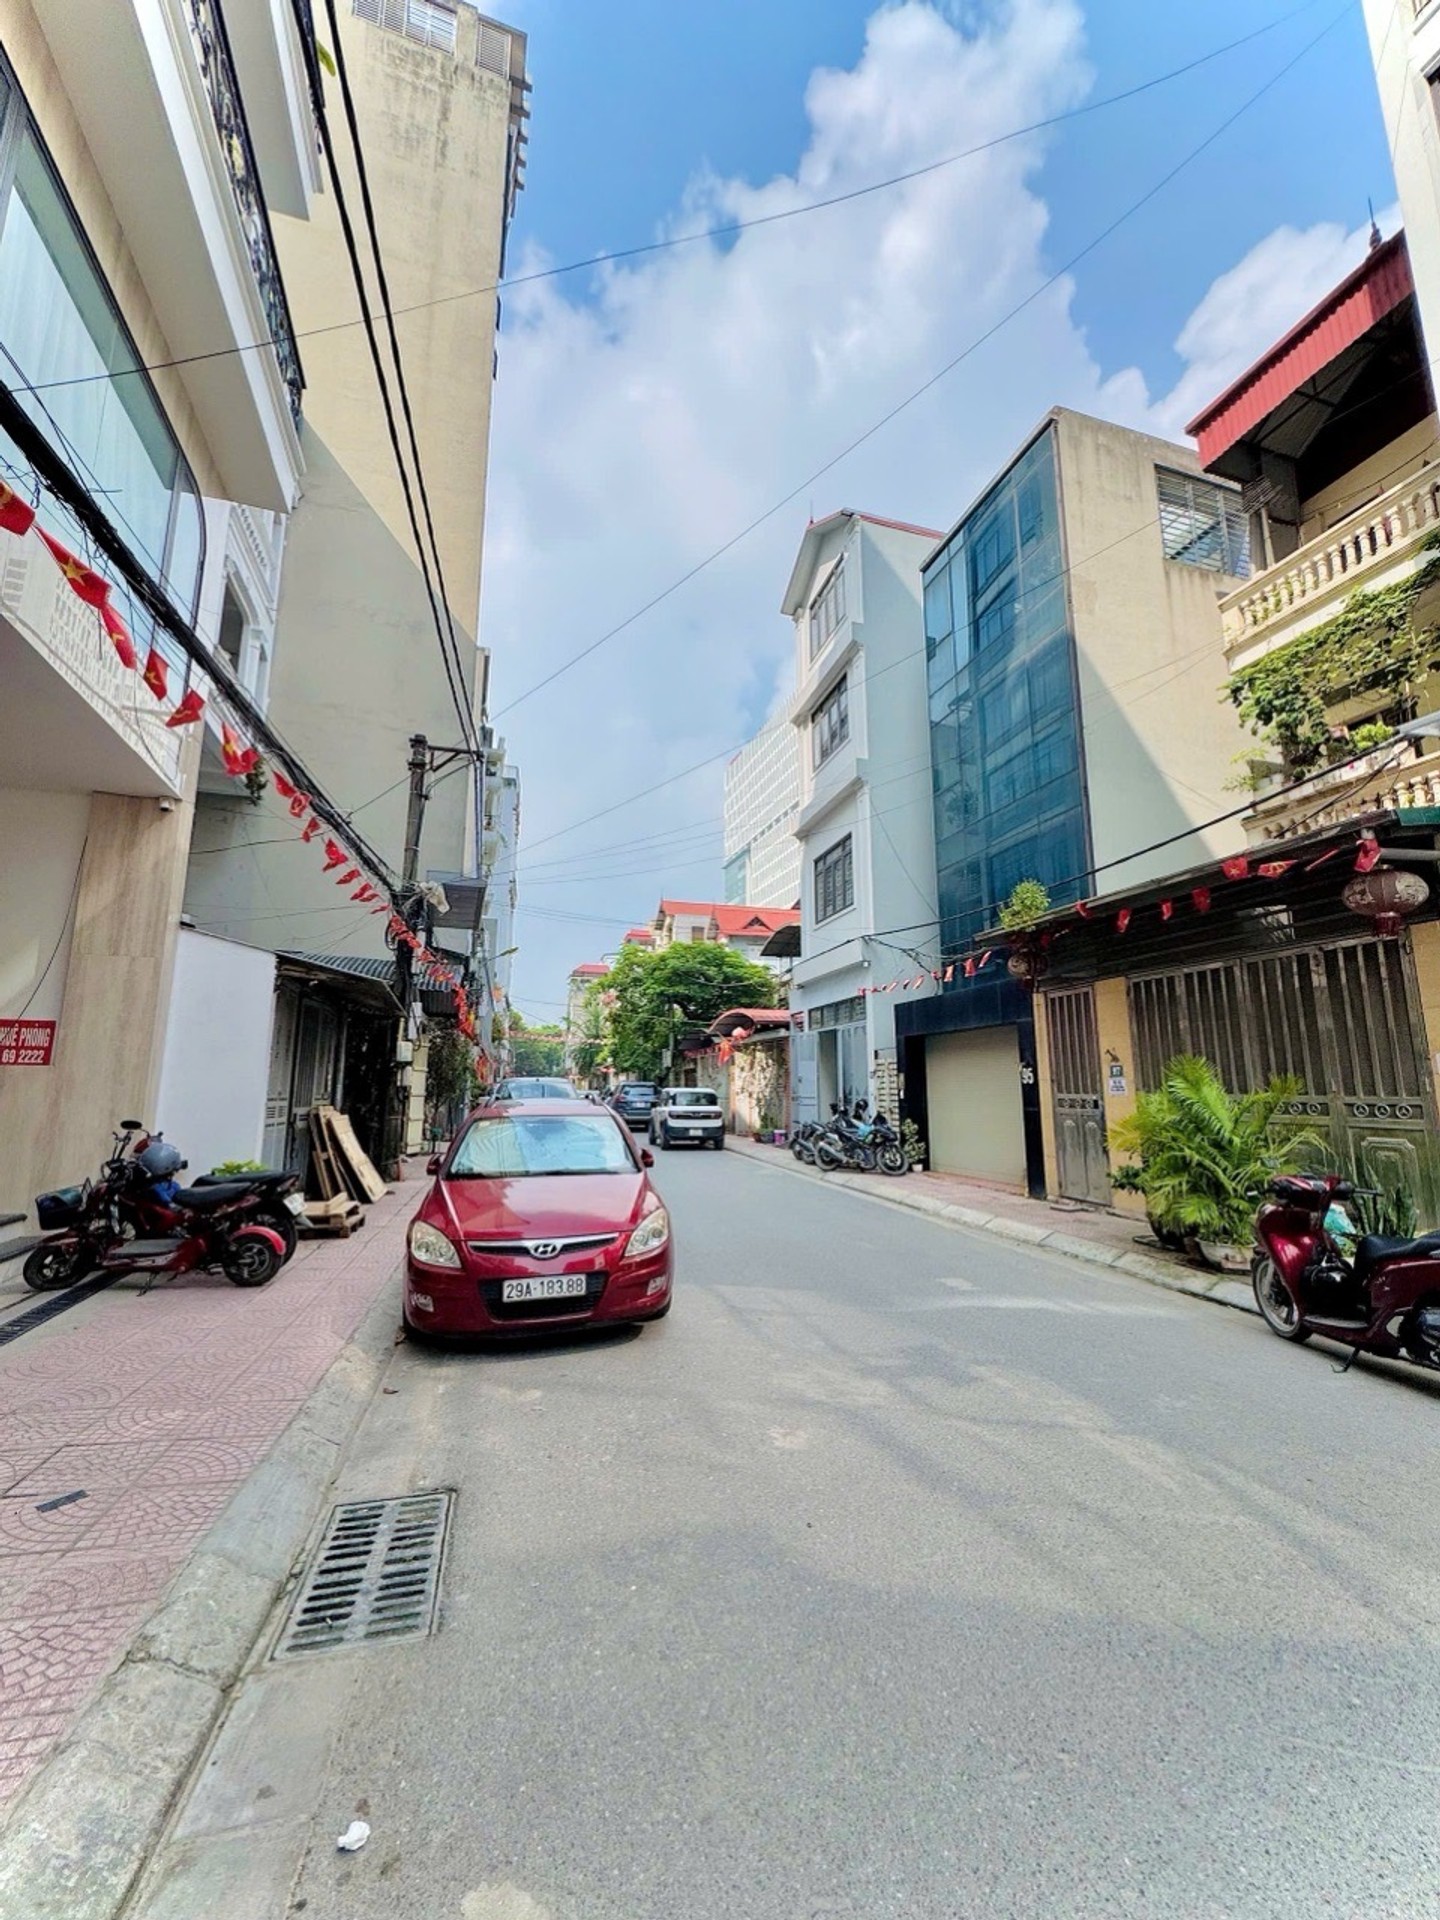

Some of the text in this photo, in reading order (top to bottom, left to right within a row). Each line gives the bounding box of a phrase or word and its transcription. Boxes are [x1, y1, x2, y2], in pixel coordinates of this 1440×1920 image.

[2, 1050, 45, 1063] 69 2222
[505, 1278, 584, 1299] 29A-183.88
